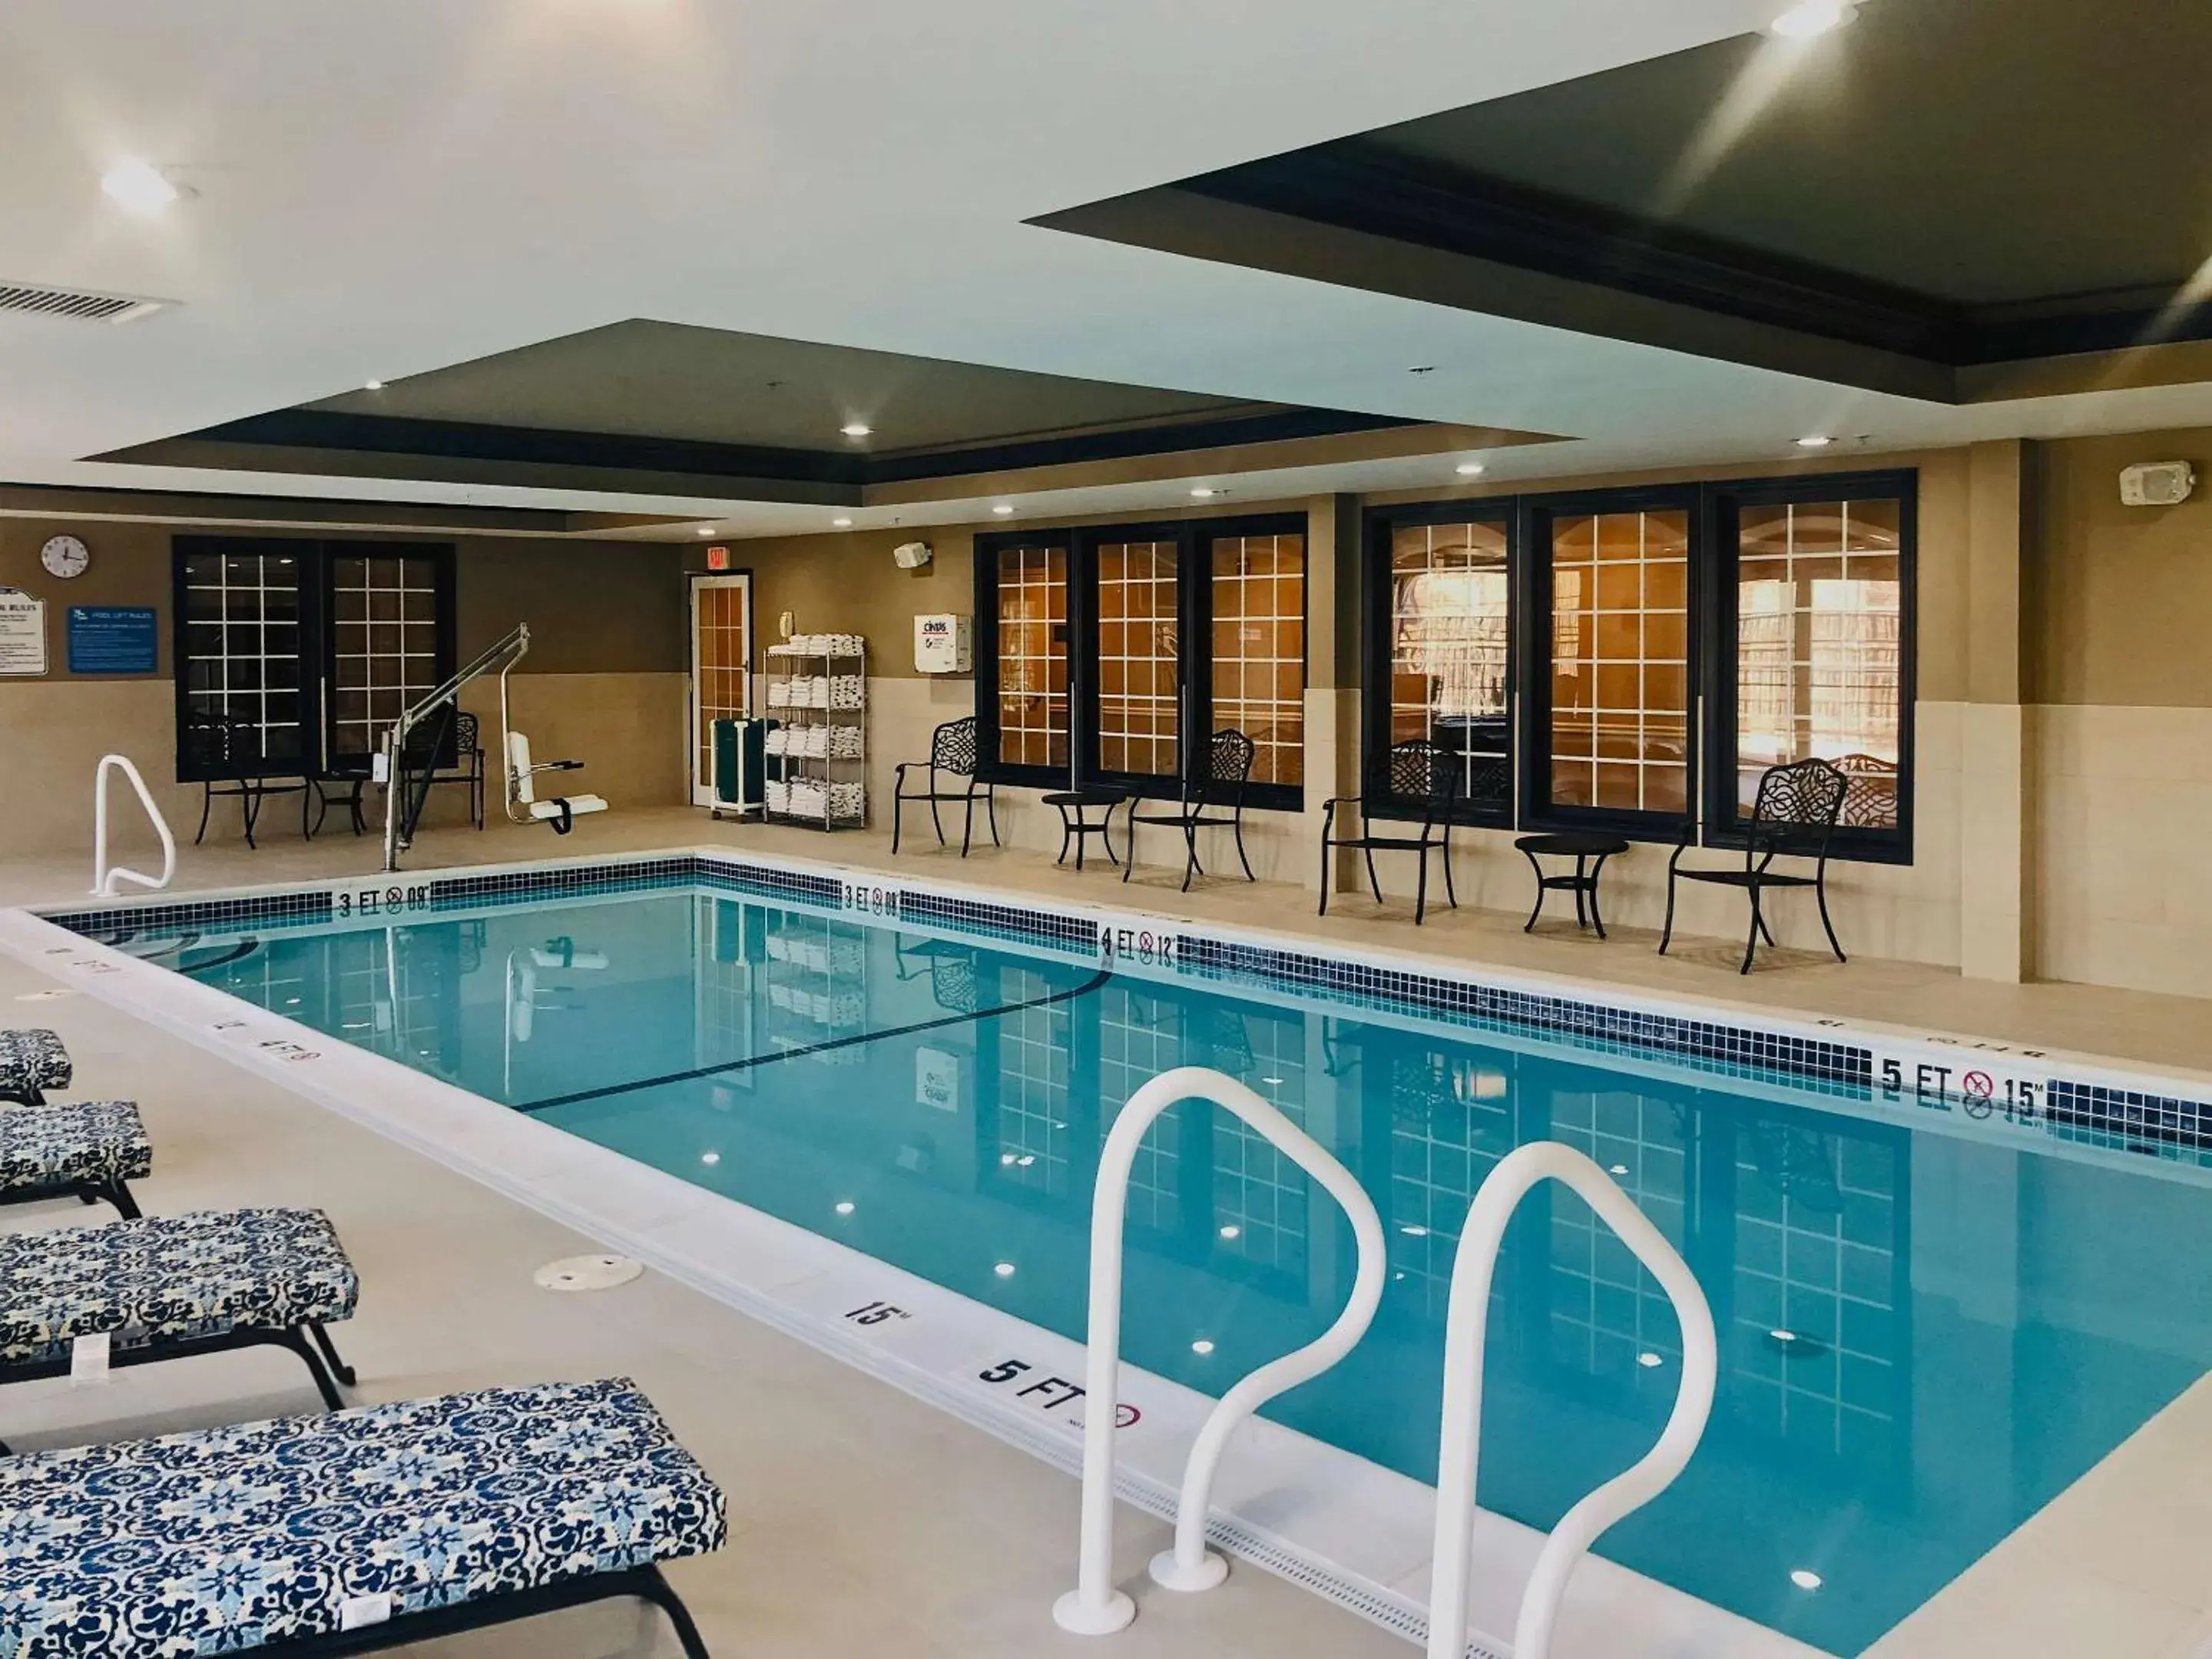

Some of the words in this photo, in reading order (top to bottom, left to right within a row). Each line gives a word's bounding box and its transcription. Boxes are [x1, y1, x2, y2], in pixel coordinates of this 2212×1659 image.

[1882, 1059, 1901, 1094] 5
[979, 1359, 1032, 1382] 5
[1016, 1377, 1086, 1409] FT
